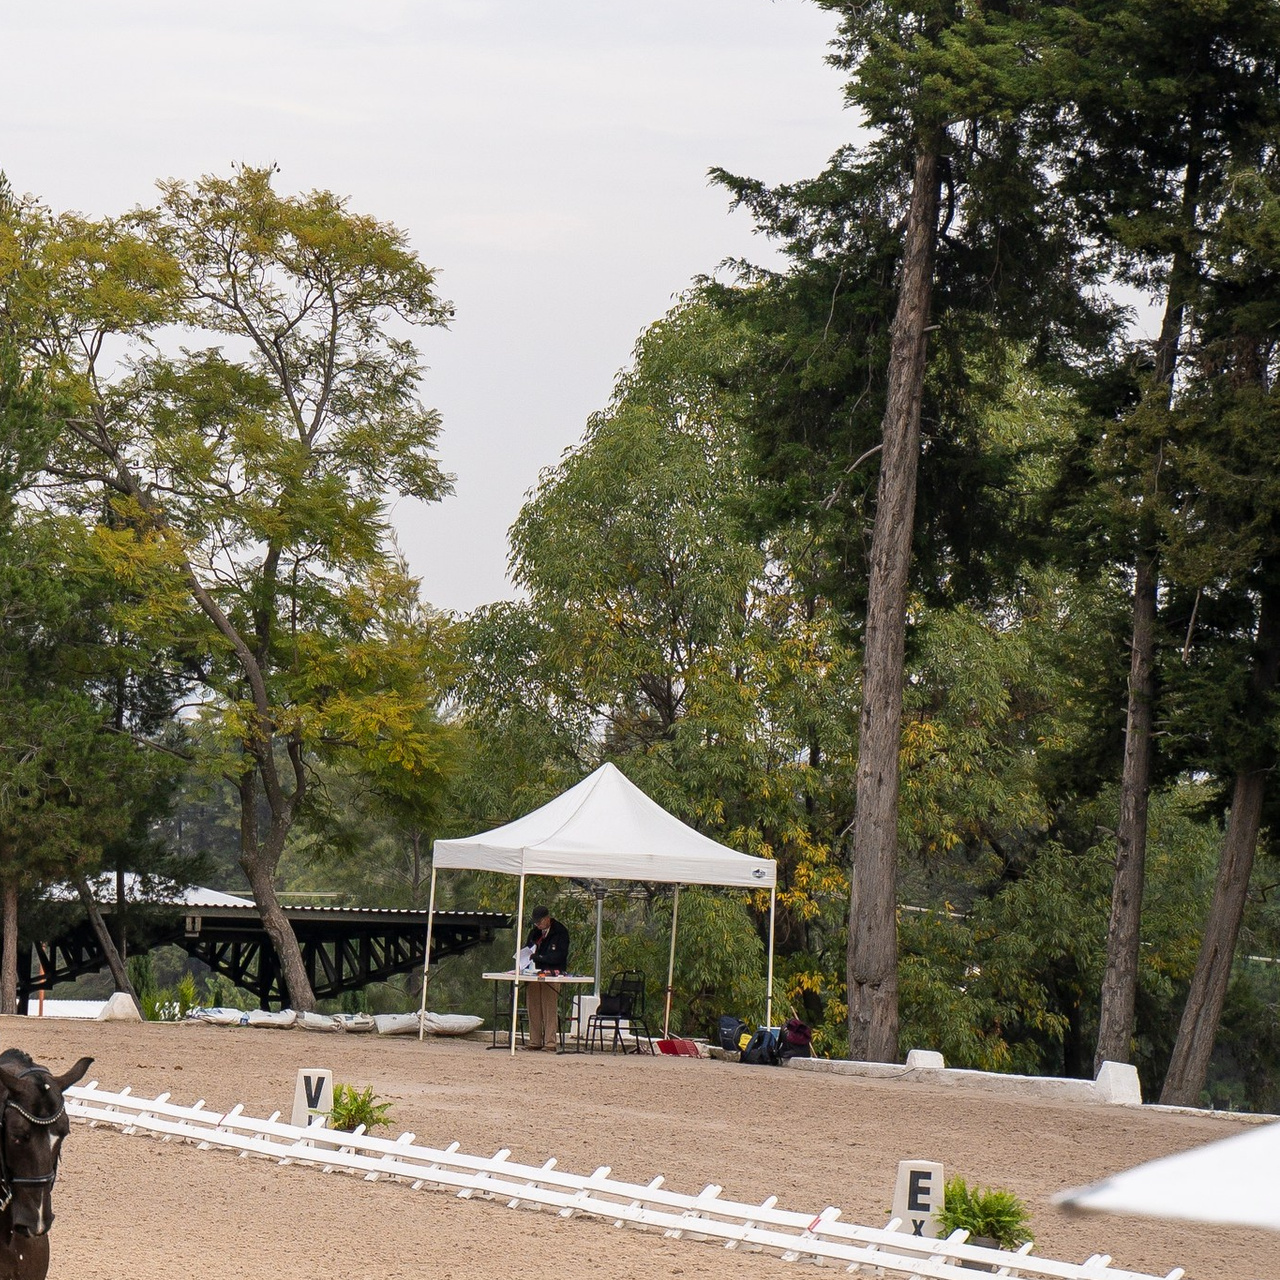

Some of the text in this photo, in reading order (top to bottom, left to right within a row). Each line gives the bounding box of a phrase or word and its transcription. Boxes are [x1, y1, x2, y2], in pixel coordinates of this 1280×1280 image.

[303, 1075, 326, 1109] V
[907, 1170, 932, 1212] E
[911, 1219, 926, 1237] X
